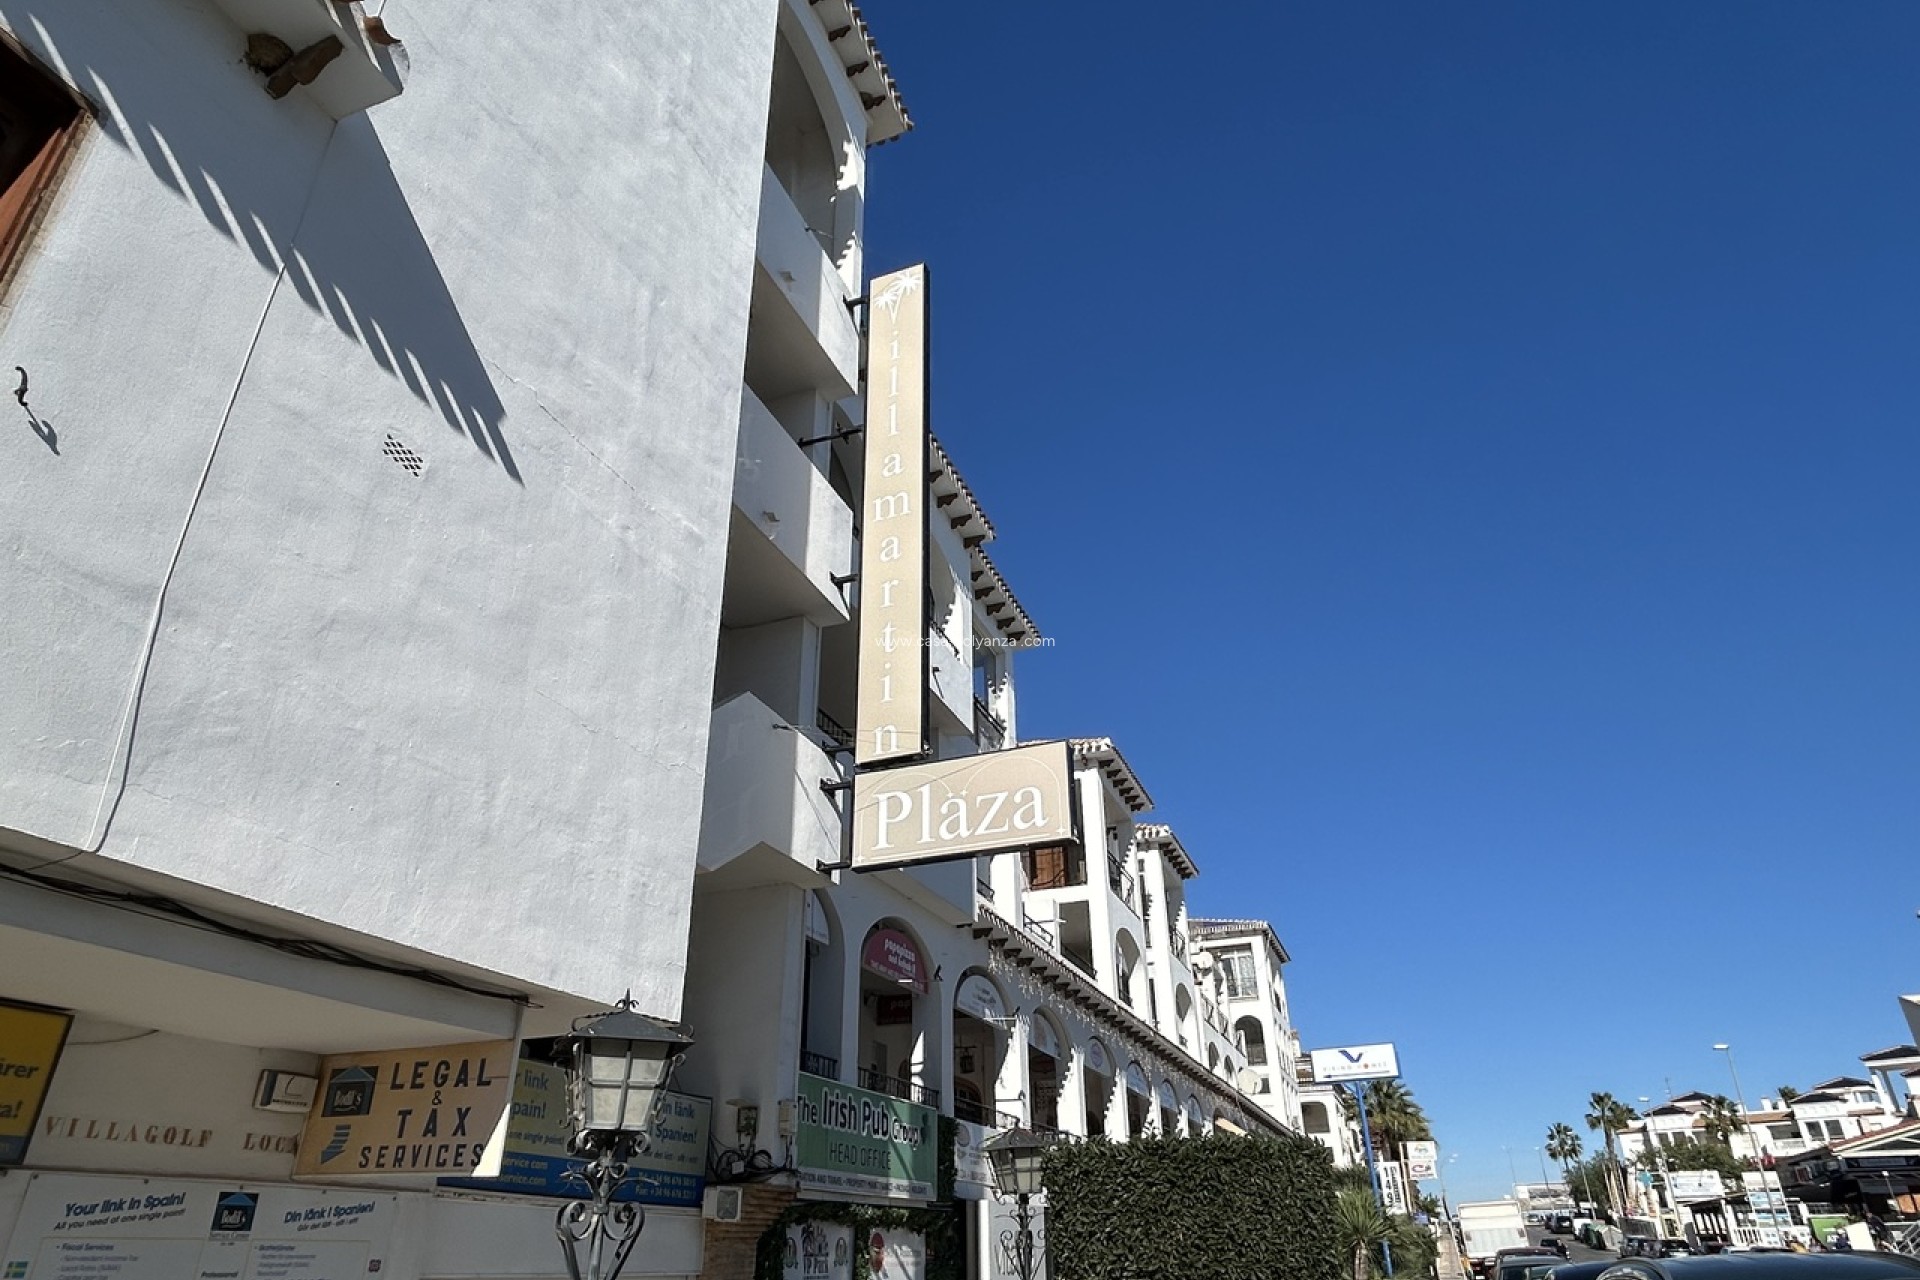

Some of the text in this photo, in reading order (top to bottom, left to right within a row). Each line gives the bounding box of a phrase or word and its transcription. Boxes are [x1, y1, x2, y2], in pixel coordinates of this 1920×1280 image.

[872, 784, 1049, 850] Plaza
[390, 1058, 493, 1091] LEGAL
[524, 1069, 550, 1090] link
[431, 1090, 443, 1106] &
[510, 1100, 547, 1120] pain!
[46, 1116, 213, 1147] VILLAGOLF
[397, 1107, 472, 1138] TAX
[797, 1087, 920, 1150] The Irish Pub Group
[358, 1143, 485, 1169] SERVICES
[829, 1141, 891, 1170] HEAD OFFICE
[65, 1192, 186, 1217] Your link in Spain!
[284, 1210, 302, 1223] Din
[333, 1201, 375, 1218] Spanien!
[67, 1221, 84, 1231] you
[86, 1216, 109, 1226] need
